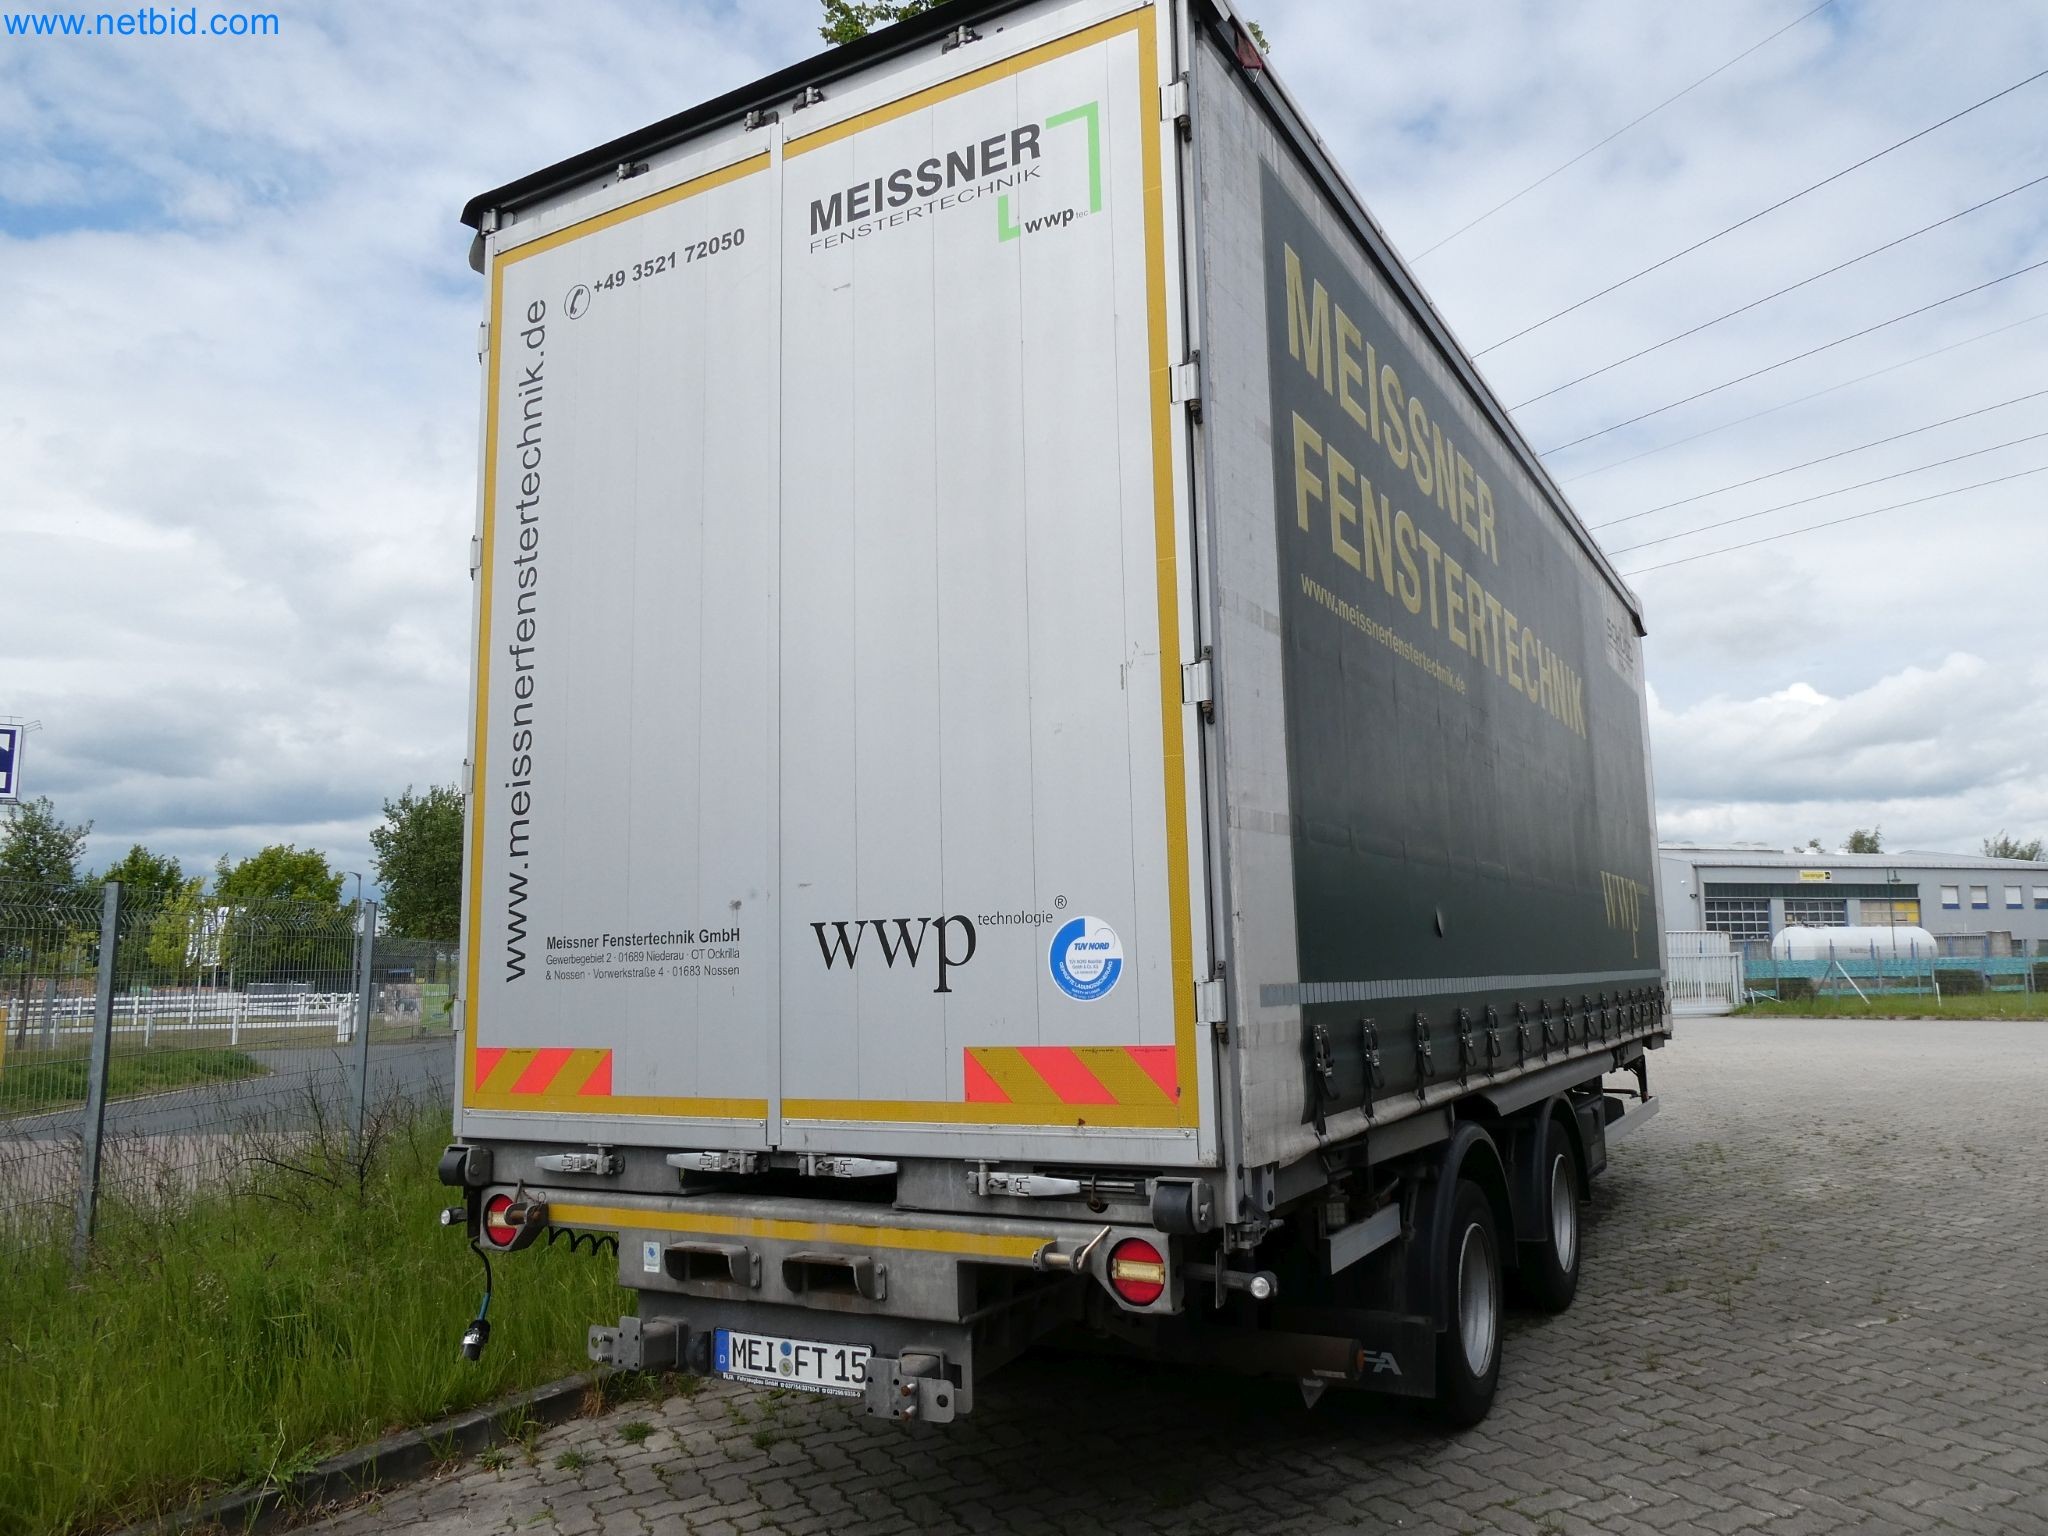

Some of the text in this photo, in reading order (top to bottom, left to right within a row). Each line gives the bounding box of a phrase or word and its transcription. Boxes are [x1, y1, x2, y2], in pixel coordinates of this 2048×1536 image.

[810, 123, 1041, 236] MEISSNER
[810, 165, 1041, 254] FENSTERTECHNIK
[1024, 206, 1075, 234] wwp
[594, 228, 745, 292] +49 3521 72050
[1284, 242, 1499, 566] MEISSNER
[1291, 410, 1587, 740] FENSTERTECHNIK
[506, 299, 546, 983] www.meissnerfenstertechnik.de
[1300, 572, 1467, 697] www.meissnerfenstertechnik.de
[546, 928, 740, 950] Meissner Fenstertechnik GmbH
[810, 910, 1054, 993] wwp technologie
[1088, 942, 1110, 950] NORD
[1600, 870, 1640, 960] wwp
[545, 952, 604, 966] Gewerbegebiet
[606, 952, 612, 963] 2
[618, 951, 644, 962] 01689
[646, 950, 684, 962] Niederau
[545, 964, 740, 980] & Nossen Vorwerkstraße 4 01683 Nossen
[719, 1337, 867, 1384] D MEI FT 15
